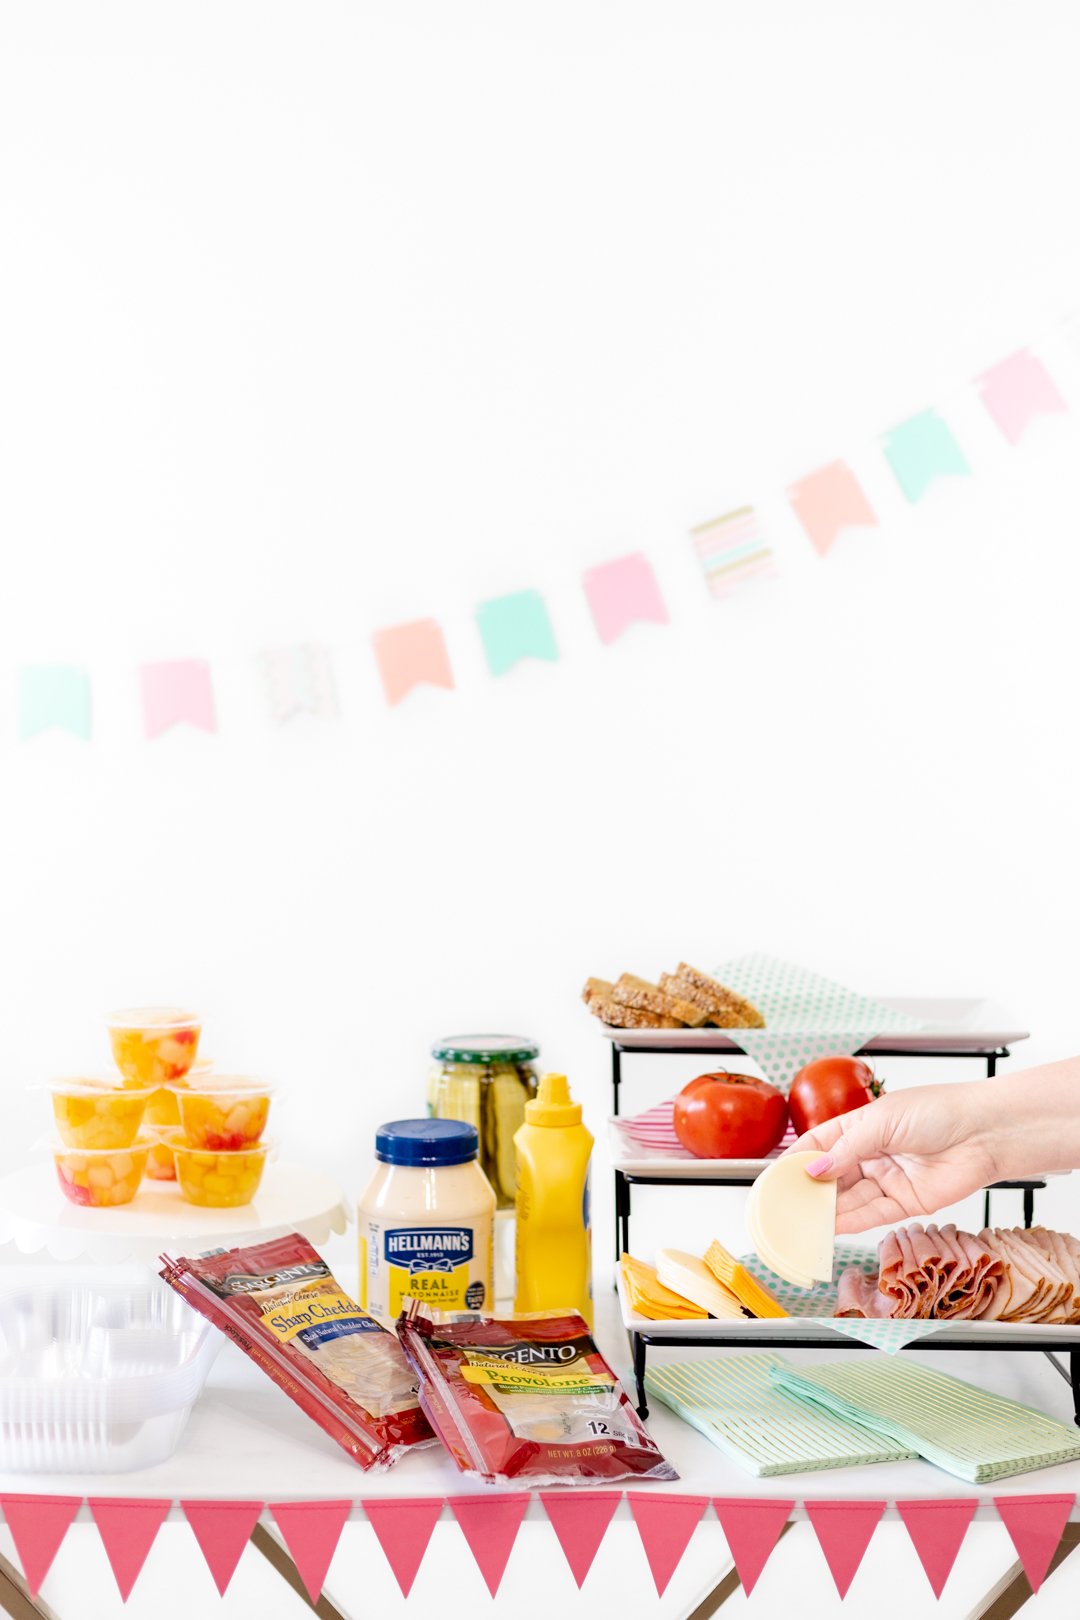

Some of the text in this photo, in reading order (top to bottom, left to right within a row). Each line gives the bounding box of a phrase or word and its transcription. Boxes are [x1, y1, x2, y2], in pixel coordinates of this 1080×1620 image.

[388, 1231, 470, 1252] HELLMANN'S
[399, 1289, 460, 1298] MAYONNAISE
[410, 1279, 449, 1290] REAL
[264, 1291, 319, 1315] Natural Cheese
[271, 1312, 313, 1334] Sharp
[307, 1299, 365, 1318] Chedda
[485, 1345, 577, 1364] RGENTO
[483, 1369, 589, 1387] Provolone
[588, 1421, 611, 1435] 12
[547, 1450, 561, 1458] NET
[582, 1448, 592, 1457] OZ
